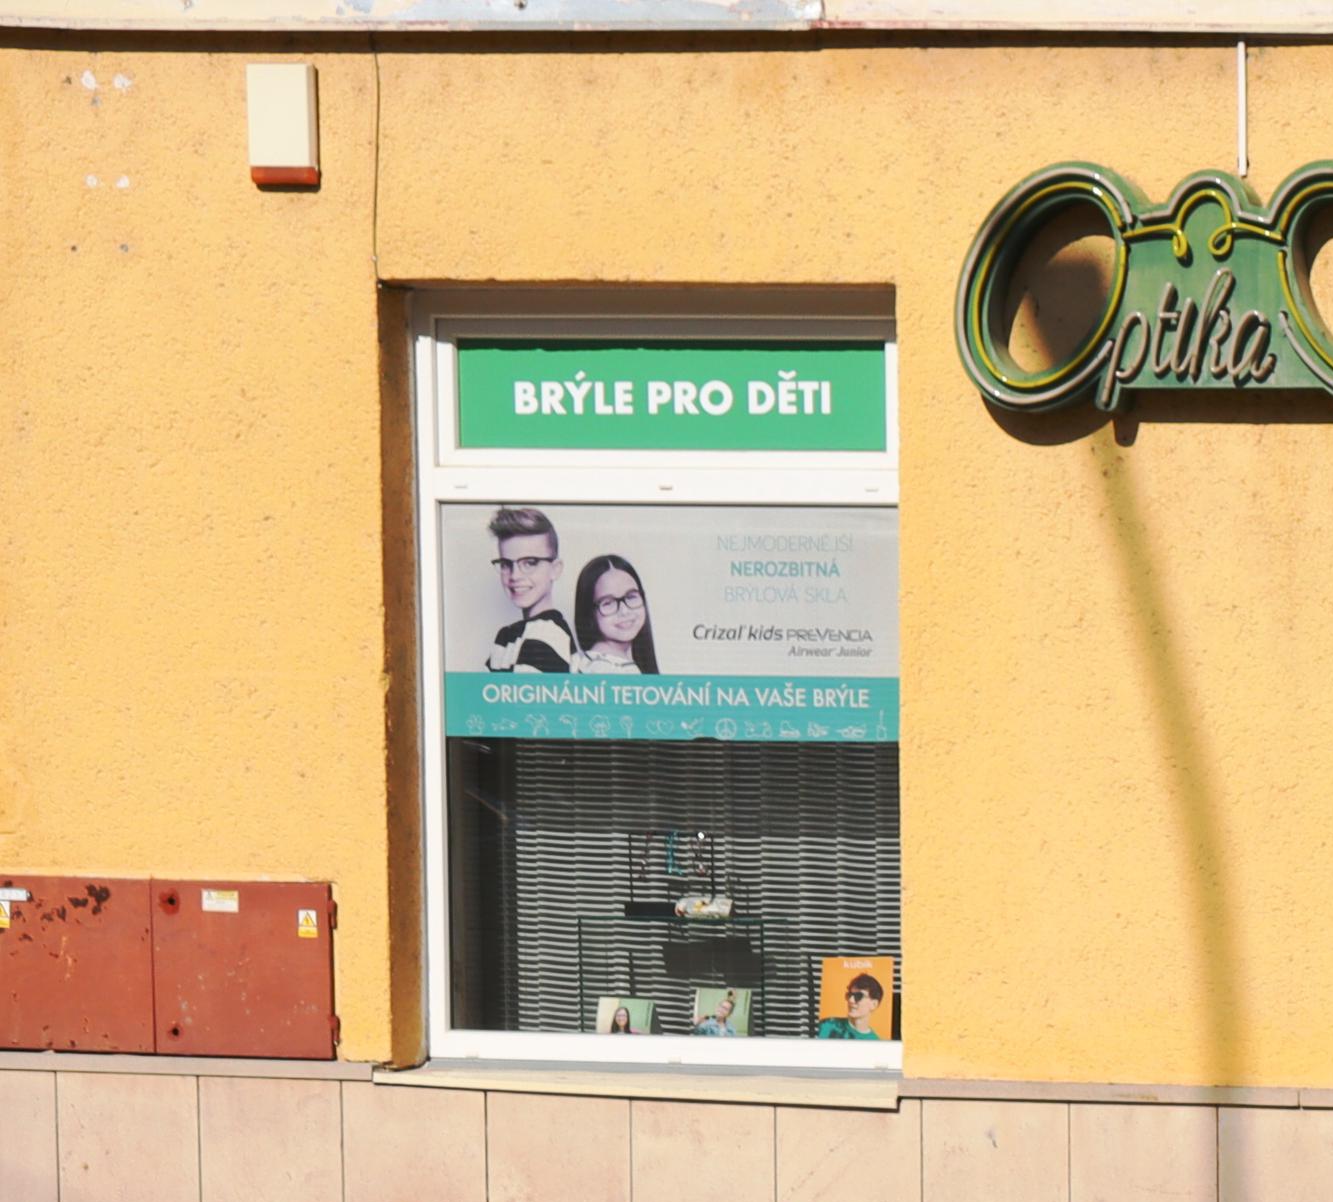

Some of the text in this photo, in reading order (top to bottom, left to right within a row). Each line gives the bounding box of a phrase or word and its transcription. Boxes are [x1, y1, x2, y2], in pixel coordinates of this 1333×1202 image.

[955, 165, 1276, 408] Optika
[513, 369, 832, 416] BRÝLE PRO DĚTI
[730, 557, 841, 578] NEROZBITNÁ
[804, 587, 849, 604] SKLA
[747, 624, 784, 642] kids
[836, 645, 873, 659] Junior
[481, 680, 870, 709] ORIGINÁLNÍ TETOVÁNÍ NA VAŠE BRÝLE
